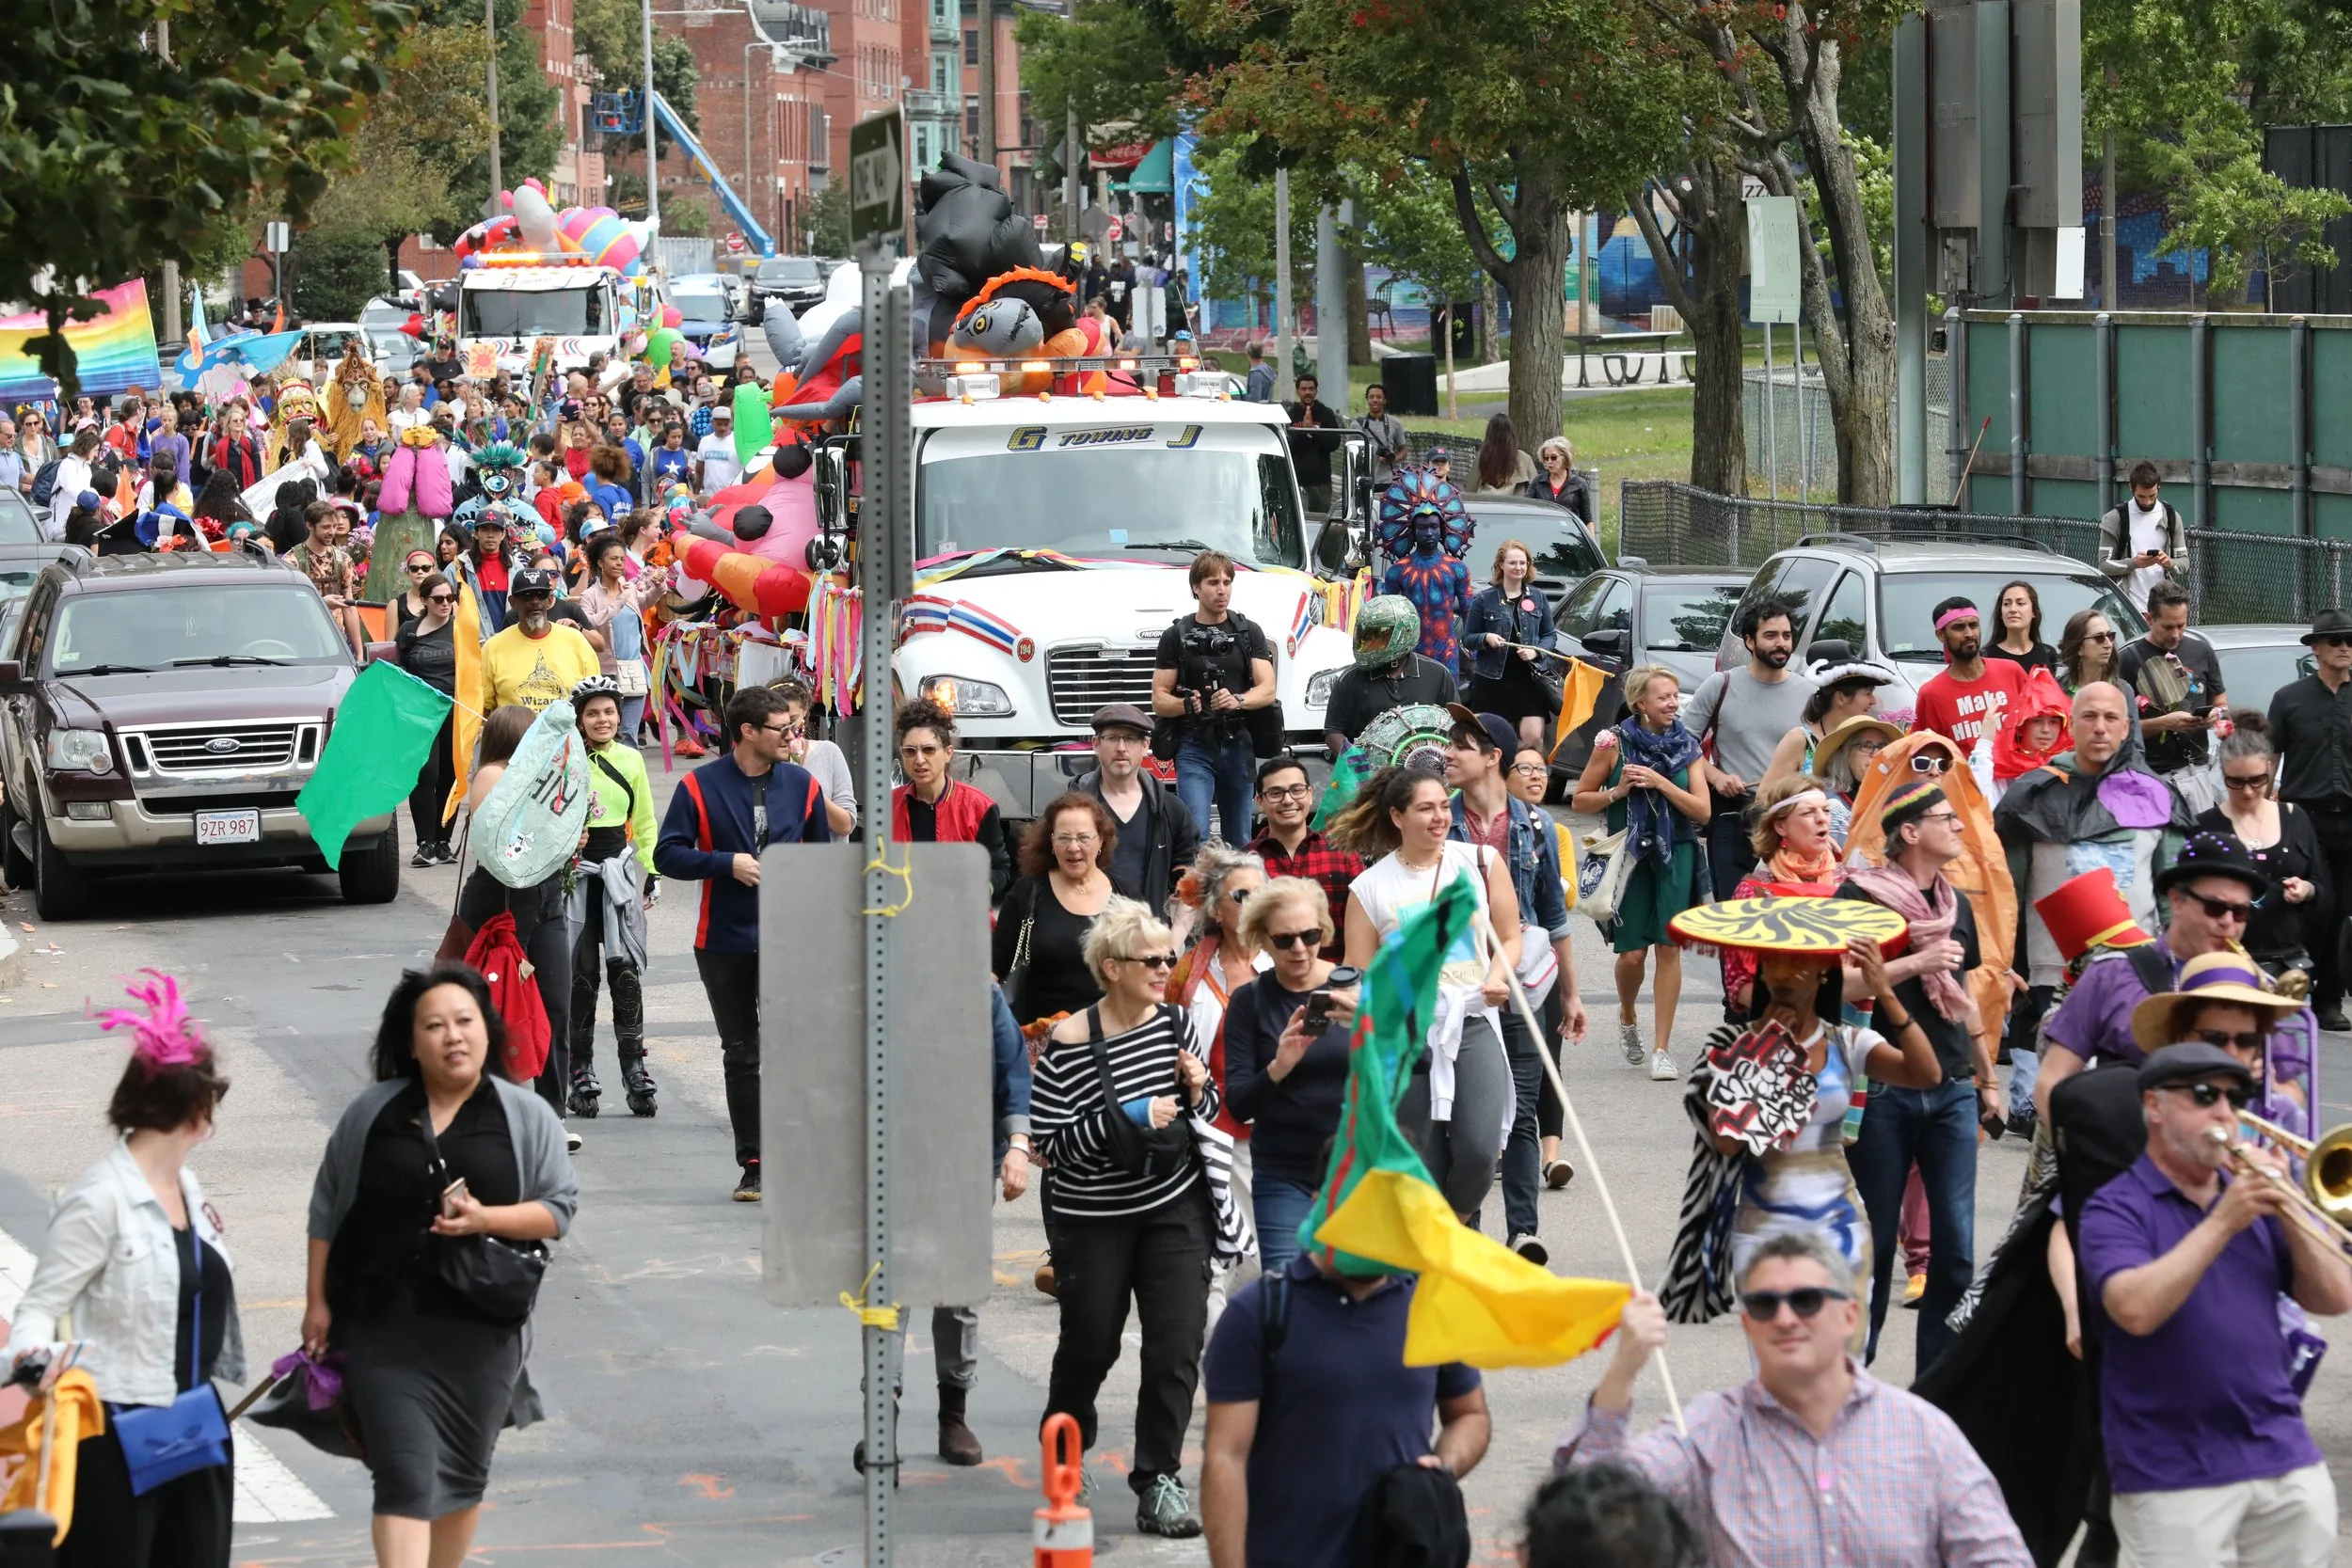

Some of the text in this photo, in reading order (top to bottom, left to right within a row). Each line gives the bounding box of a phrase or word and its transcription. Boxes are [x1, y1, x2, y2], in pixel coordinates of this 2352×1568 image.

[1007, 424, 1204, 451] G TOWING J
[1019, 643, 1031, 656] 194
[520, 694, 562, 706] Wizar
[1956, 690, 2009, 717] Make
[213, 740, 232, 750] Ford
[200, 819, 255, 836] 9ZR 987
[1710, 1060, 1760, 1106] The
